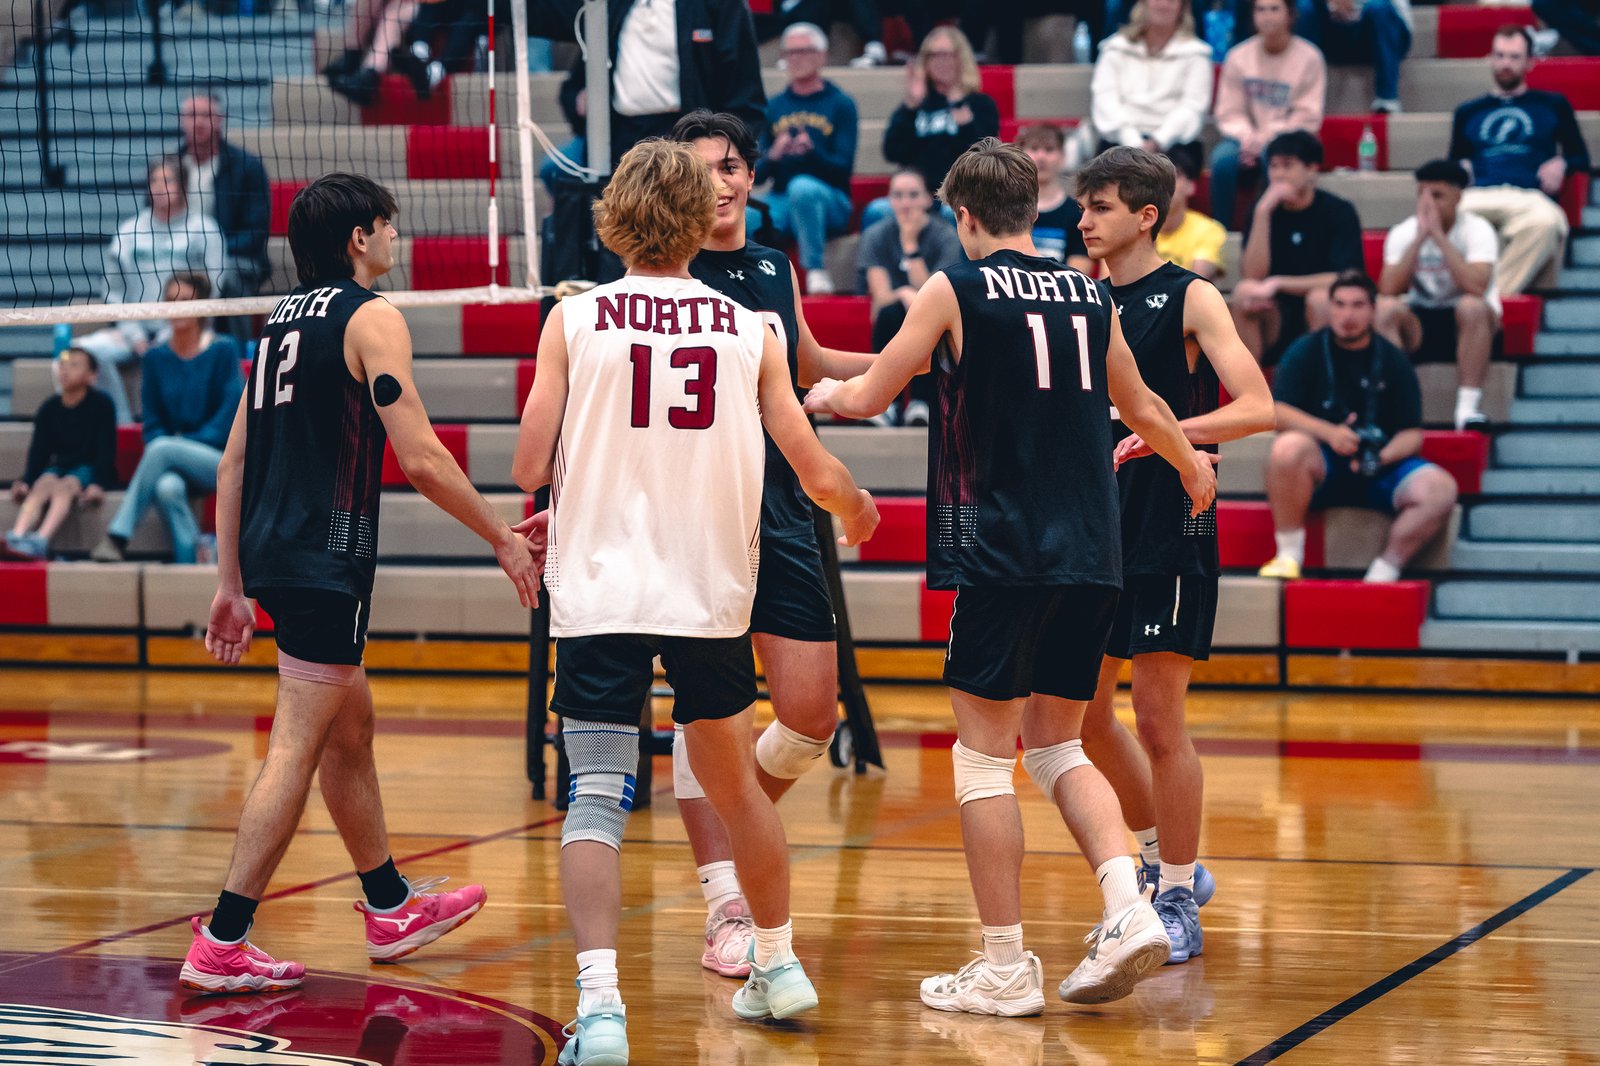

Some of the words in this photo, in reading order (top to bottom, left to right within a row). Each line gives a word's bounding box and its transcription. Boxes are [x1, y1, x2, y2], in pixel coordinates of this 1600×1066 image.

[266, 286, 344, 325] ORTH
[594, 292, 739, 336] NORTH
[979, 265, 1102, 307] NORTH
[253, 329, 301, 411] 12
[1024, 312, 1093, 391] 11
[629, 342, 718, 430] 13
